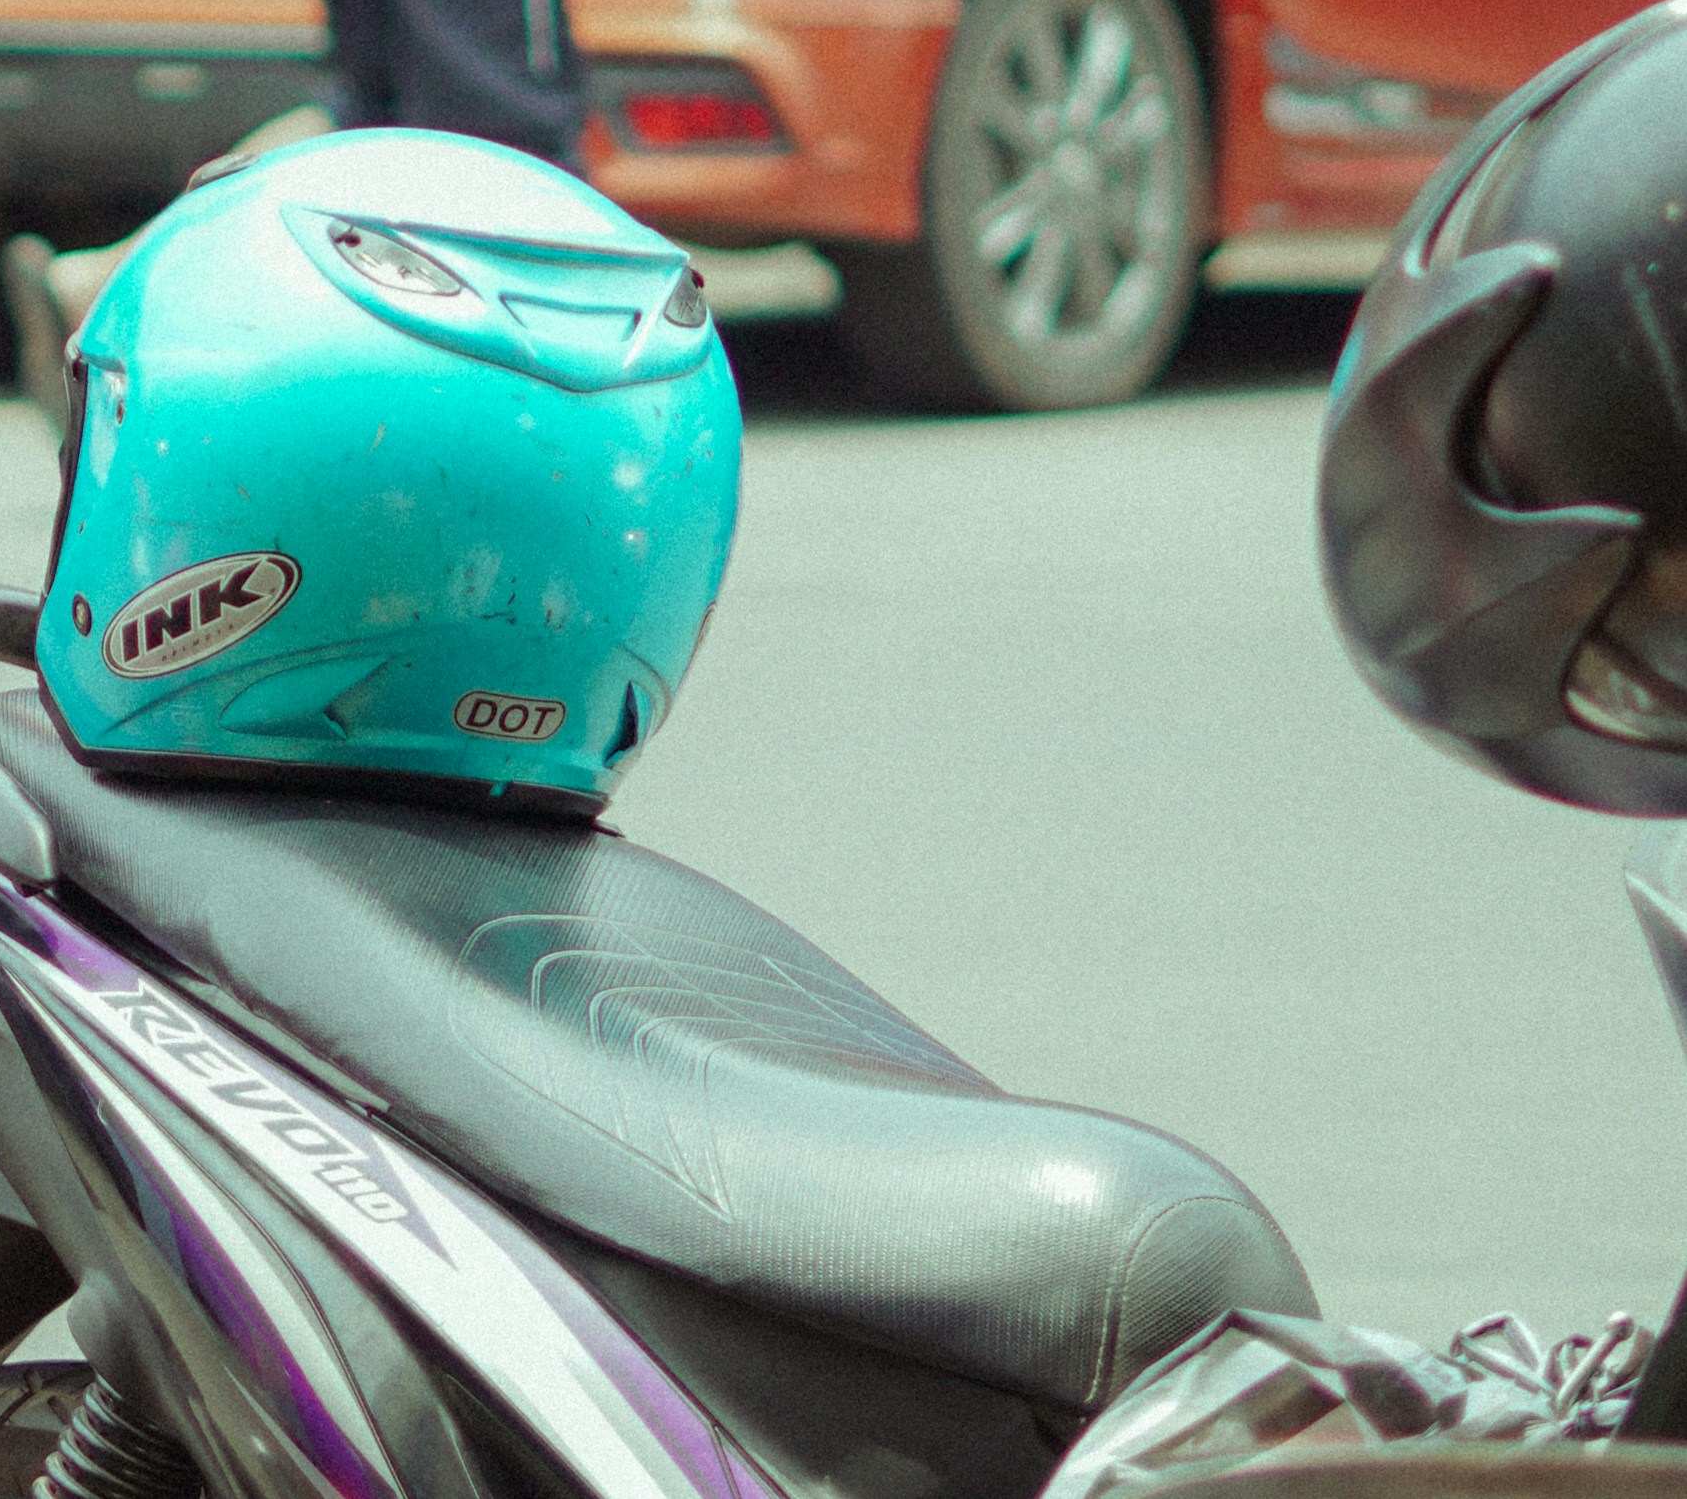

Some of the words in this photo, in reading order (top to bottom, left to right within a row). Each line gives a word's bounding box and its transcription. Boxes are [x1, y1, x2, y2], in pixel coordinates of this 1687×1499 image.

[121, 559, 264, 663] INK
[466, 698, 556, 735] DOT
[99, 986, 355, 1155] REVO
